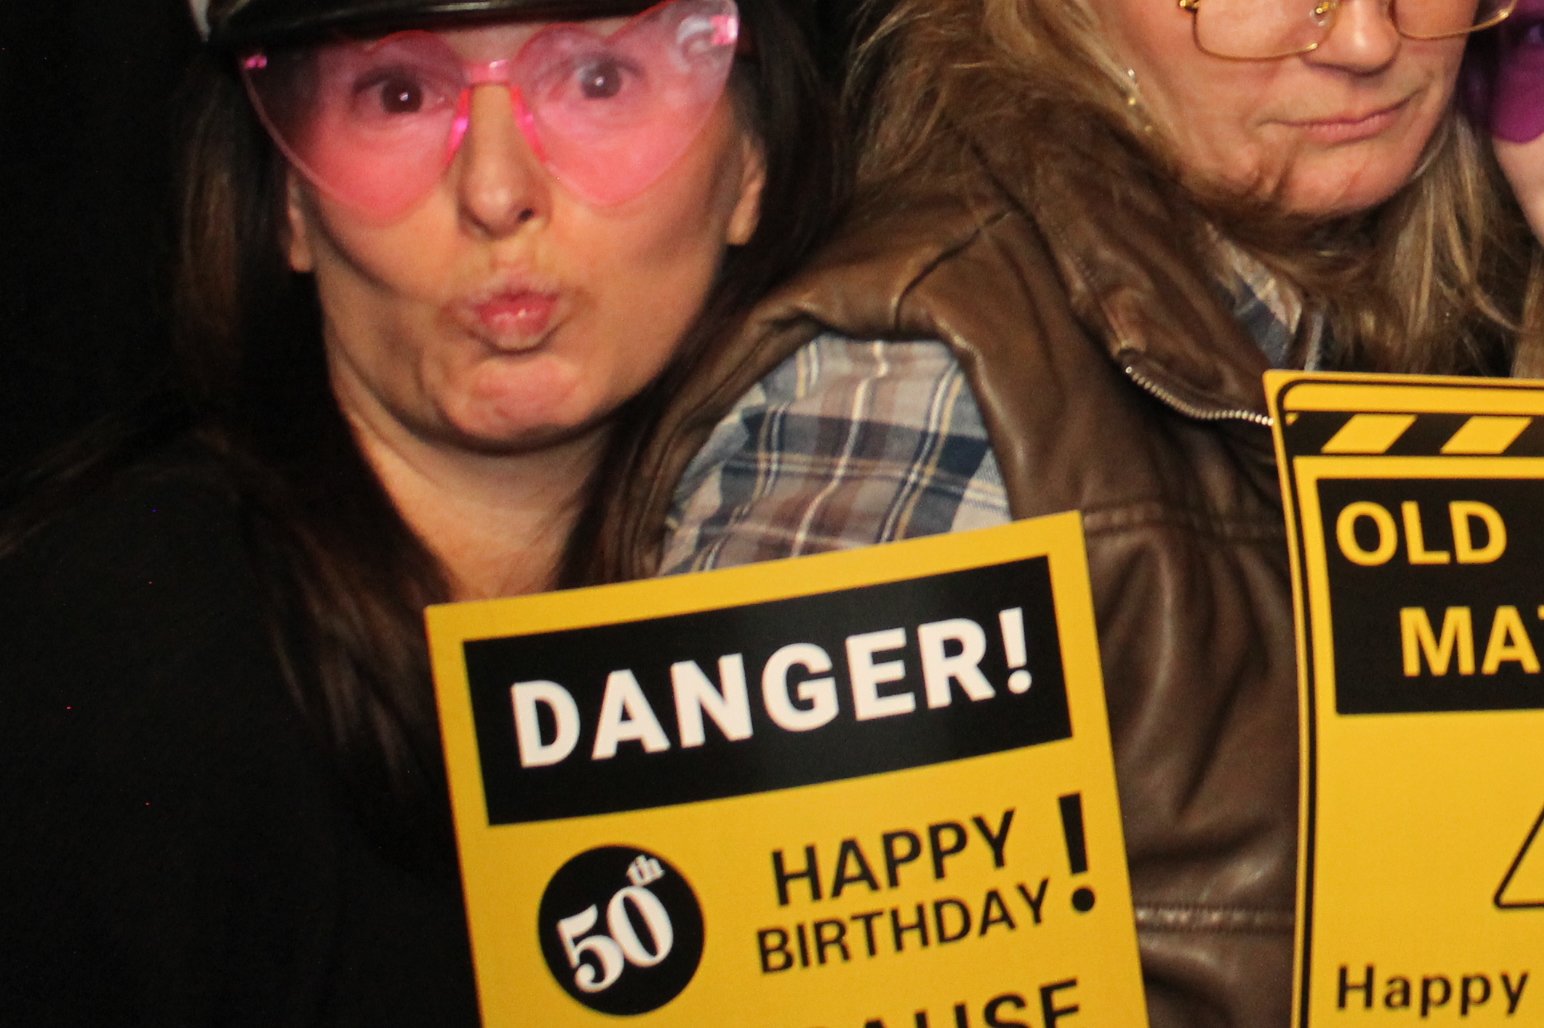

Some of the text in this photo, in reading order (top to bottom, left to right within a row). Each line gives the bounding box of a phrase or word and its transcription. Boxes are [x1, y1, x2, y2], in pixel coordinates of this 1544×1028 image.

[1335, 500, 1507, 567] OLD
[510, 607, 1032, 768] DANGER!
[771, 809, 1015, 907] HAPPY
[757, 878, 1049, 974] BIRTHDAY
[1337, 966, 1529, 1019] Happy
